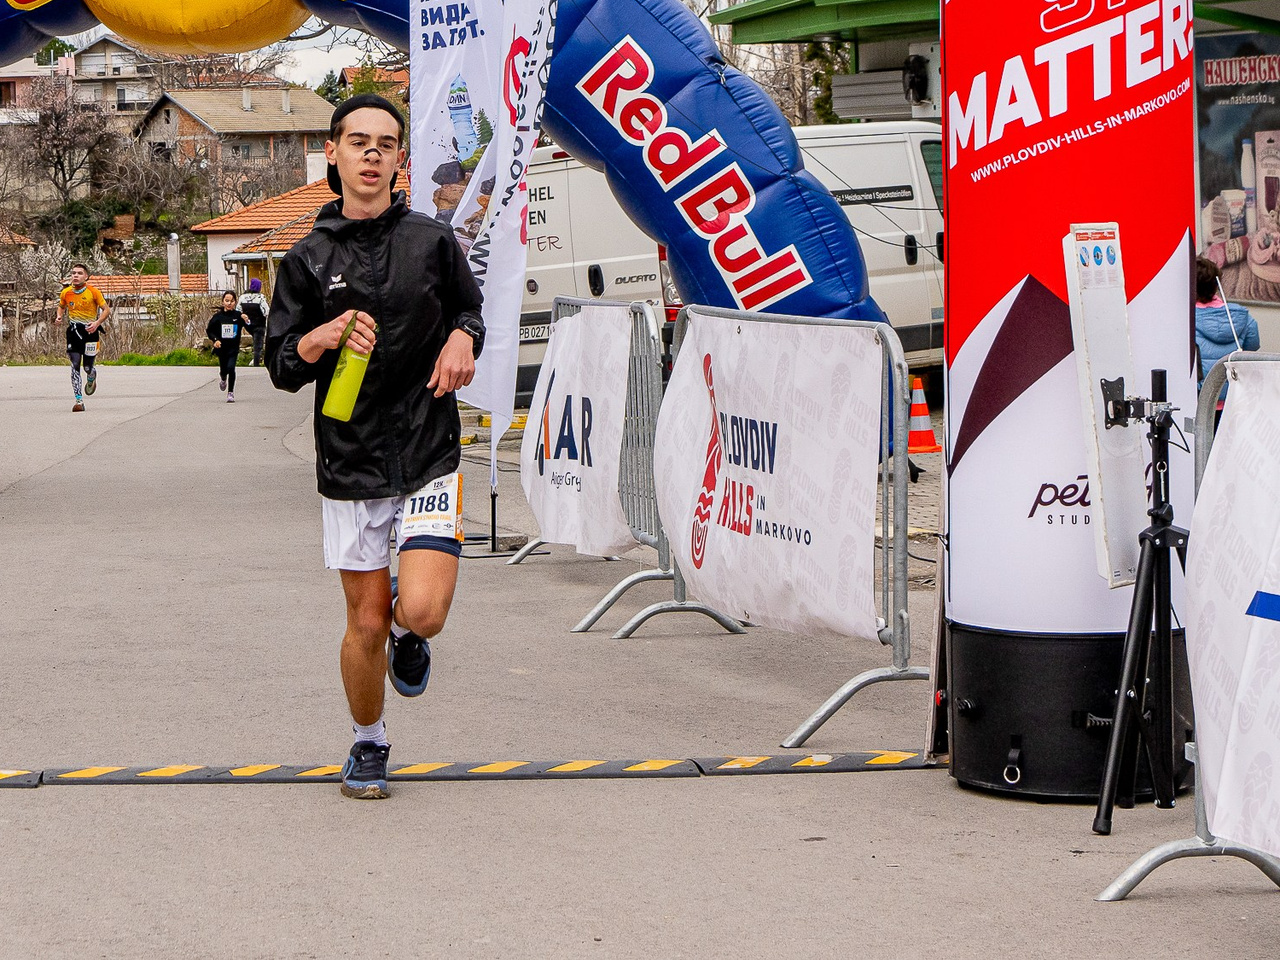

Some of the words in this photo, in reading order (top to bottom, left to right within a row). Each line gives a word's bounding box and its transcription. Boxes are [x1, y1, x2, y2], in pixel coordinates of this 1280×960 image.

[422, 30, 447, 52] ЗА
[970, 76, 1191, 184] WWW.PLOVDIV-HILLS-IN-MARKOVO.COM
[580, 38, 724, 188] Red
[680, 166, 807, 310] Bull
[614, 273, 657, 285] DUCATO
[720, 411, 778, 475] PLOVDIV
[410, 492, 449, 515] 1188
[717, 476, 755, 537] HILLS
[756, 495, 766, 512] IN
[755, 518, 812, 546] MARKOVO
